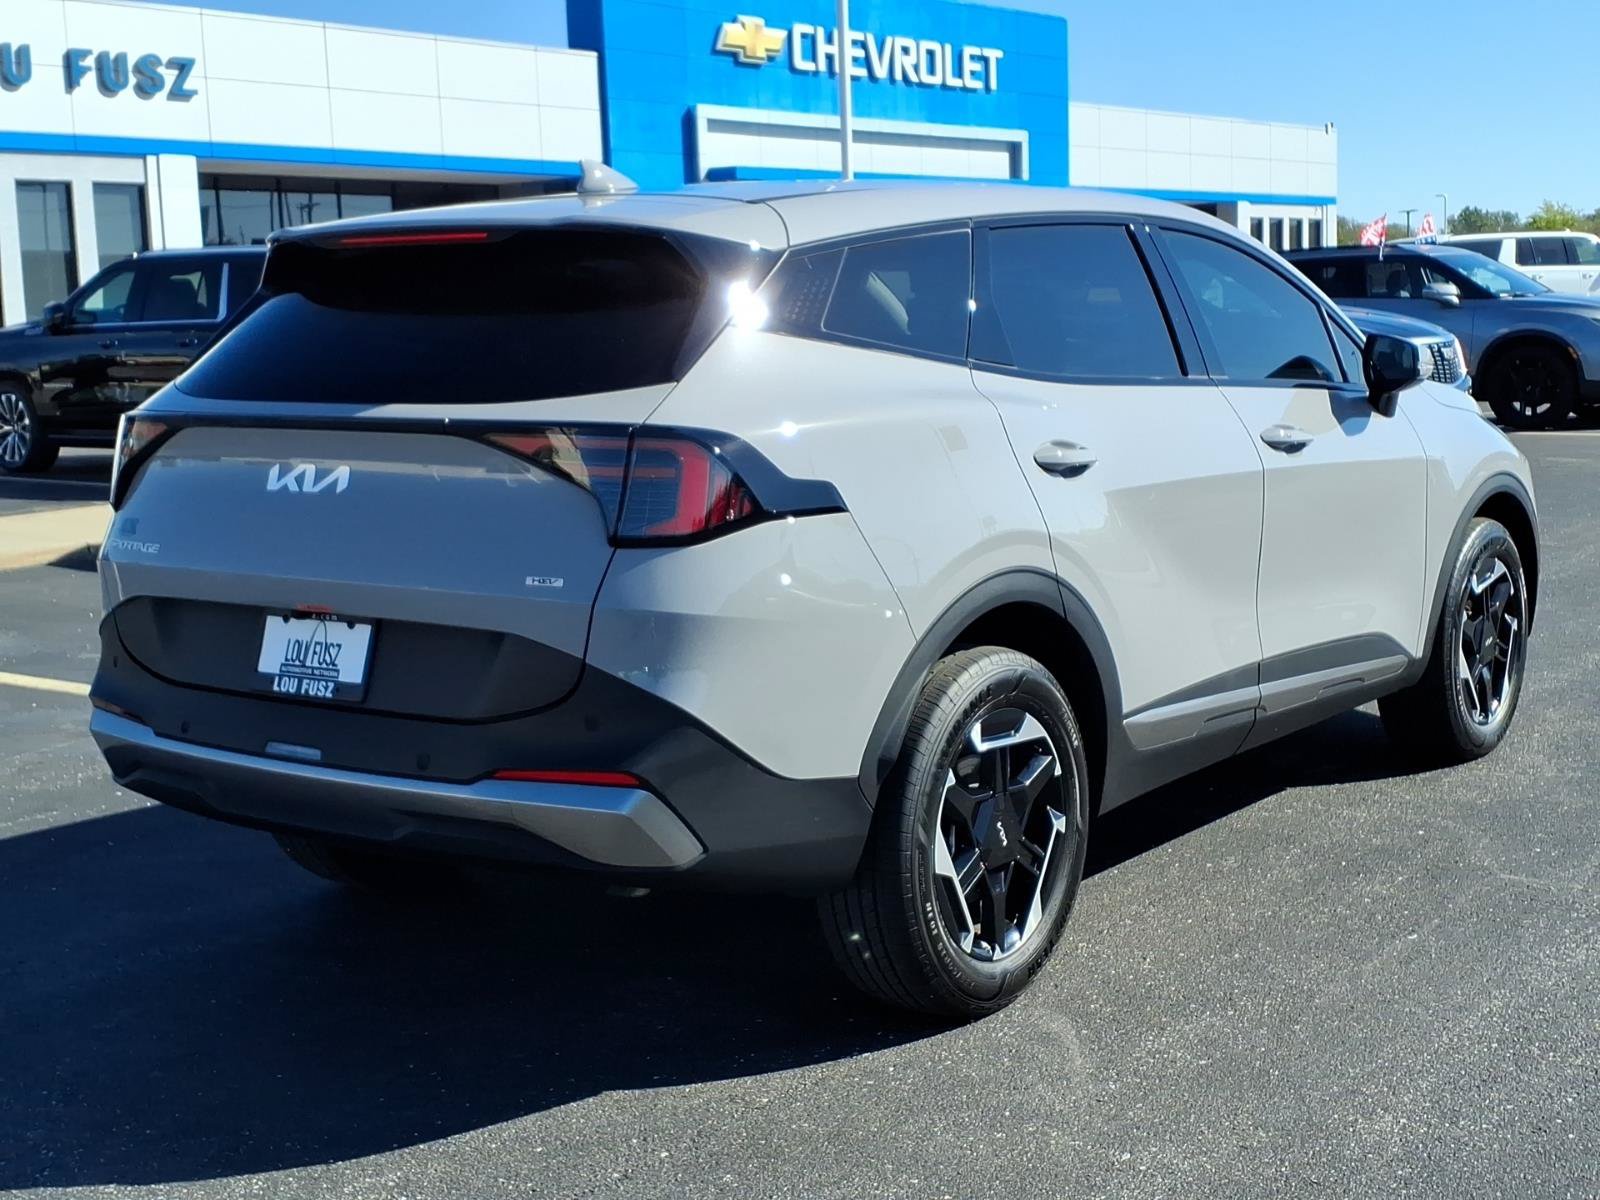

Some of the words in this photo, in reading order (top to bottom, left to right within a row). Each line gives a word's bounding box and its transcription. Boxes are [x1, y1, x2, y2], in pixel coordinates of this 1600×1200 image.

[791, 23, 1004, 91] CHEVROLET
[62, 47, 198, 103] FUSZ
[266, 463, 351, 494] KIA
[284, 638, 309, 665] LOU
[310, 641, 342, 667] FUSZ
[272, 676, 299, 694] LOU
[300, 679, 335, 698] FUSZ
